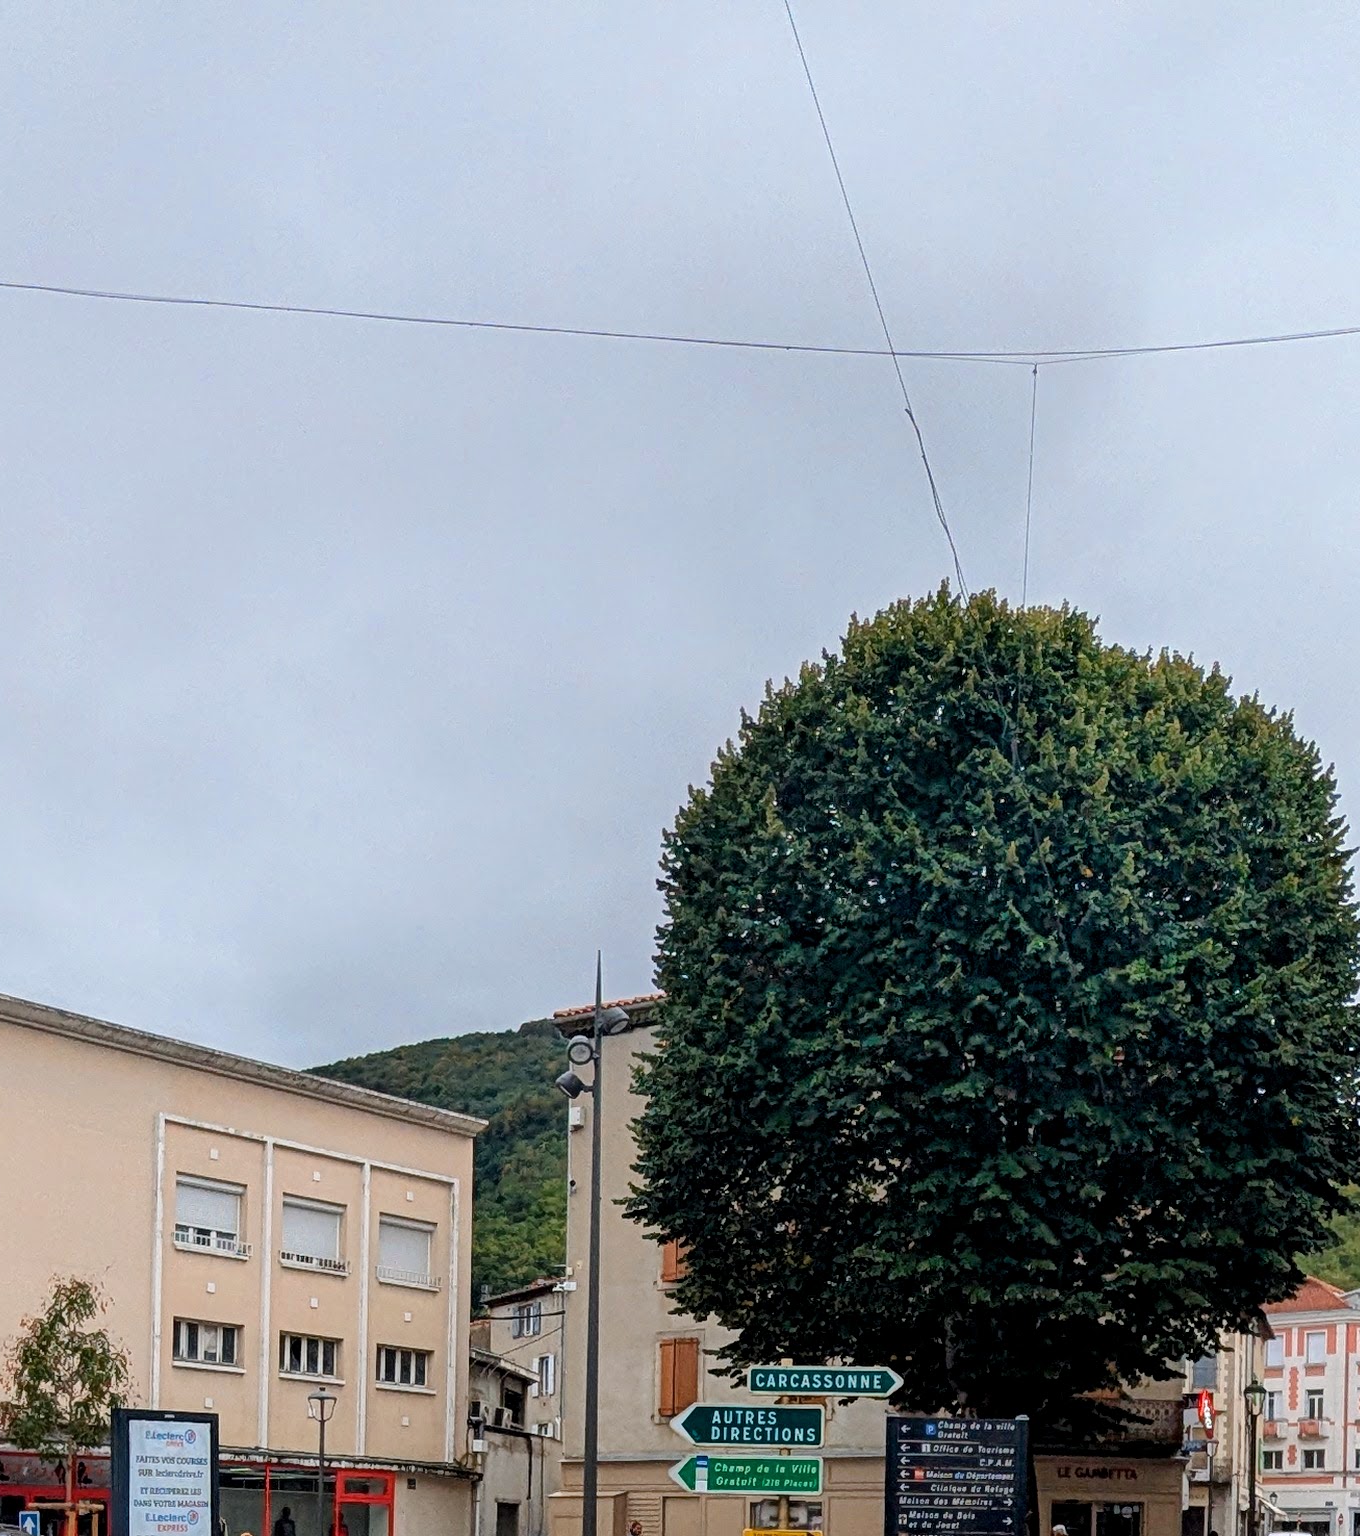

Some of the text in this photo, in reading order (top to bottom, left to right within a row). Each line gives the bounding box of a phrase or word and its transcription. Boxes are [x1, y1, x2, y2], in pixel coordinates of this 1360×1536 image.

[755, 1373, 882, 1389] CARCASSONNE
[712, 1411, 777, 1425] AUTRES
[938, 1421, 966, 1430] Champ
[970, 1422, 980, 1430] de
[984, 1422, 992, 1430] la
[710, 1427, 816, 1442] DIRECTIONS
[933, 1444, 1015, 1454] Office de Tourisme
[980, 1459, 1014, 1467] C.P.A.M.
[714, 1463, 817, 1475] Champ de la Ville
[1057, 1467, 1071, 1478] LE
[926, 1471, 953, 1479] Maison
[716, 1477, 756, 1487] Gratuit
[899, 1496, 929, 1505] Maison
[933, 1496, 948, 1505] des
[908, 1511, 939, 1519] Maison
[157, 1524, 188, 1532] EXPRESS
